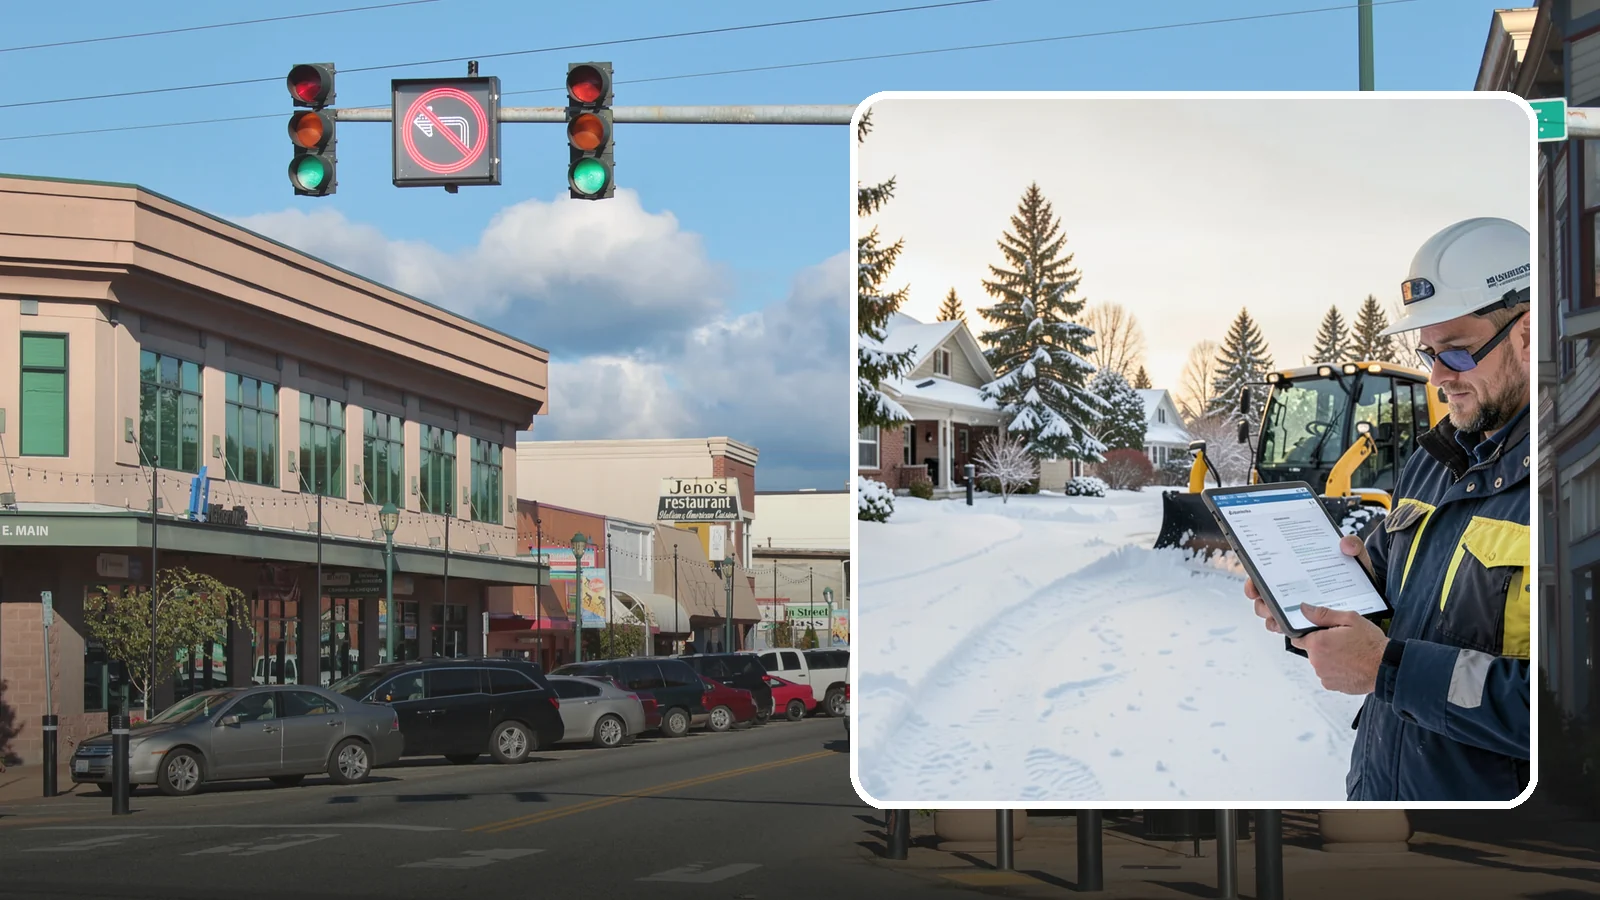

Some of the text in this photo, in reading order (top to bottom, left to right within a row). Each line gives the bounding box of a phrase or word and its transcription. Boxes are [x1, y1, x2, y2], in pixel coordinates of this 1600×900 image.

[669, 480, 727, 495] Jeno's
[665, 496, 731, 509] restaurant
[658, 510, 681, 519] Italian
[685, 509, 714, 519] American
[715, 509, 737, 519] Cuisine
[2, 525, 49, 536] E. MAIN
[797, 607, 828, 617] Street
